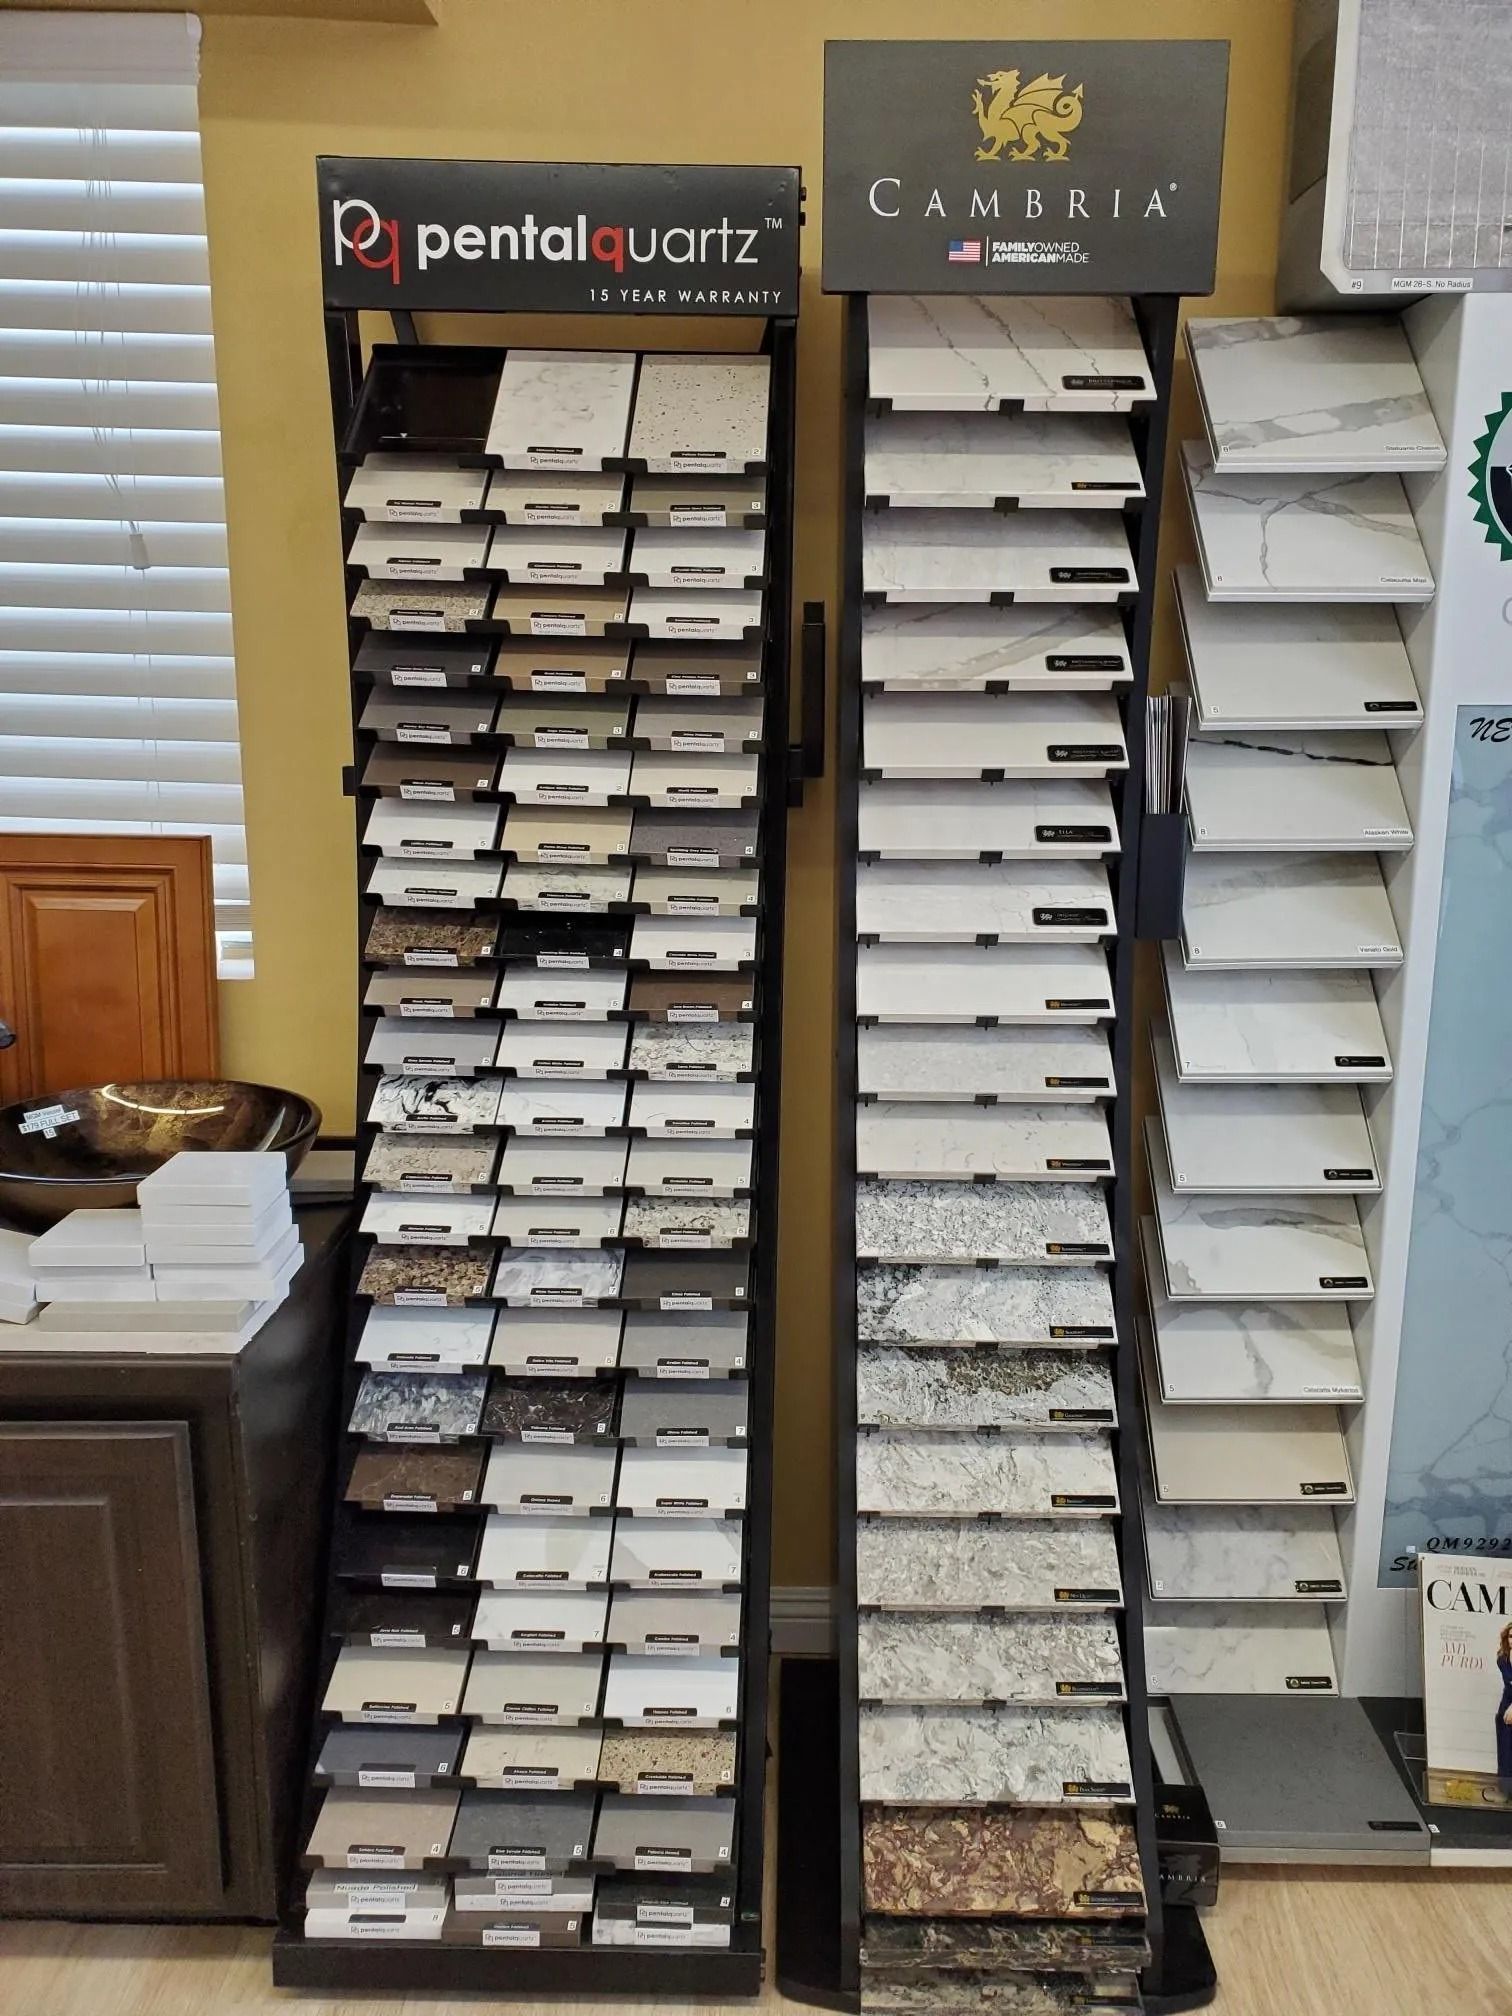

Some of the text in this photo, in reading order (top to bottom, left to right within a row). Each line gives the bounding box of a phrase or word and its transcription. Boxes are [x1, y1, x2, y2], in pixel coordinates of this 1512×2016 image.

[869, 177, 1168, 218] CAMBRIA
[417, 214, 759, 273] pentalquartz
[992, 241, 1080, 253] FAMILYOWNED
[991, 252, 1090, 264] AMERICANMADE
[1393, 280, 1412, 288] MGM
[1435, 280, 1445, 288] No
[1447, 280, 1471, 288] Radius
[589, 288, 782, 304] 15 YEAR WARRANTY
[40, 1118, 58, 1127] FULL
[60, 1112, 77, 1121] SET
[1441, 1655, 1487, 1670] PURDY
